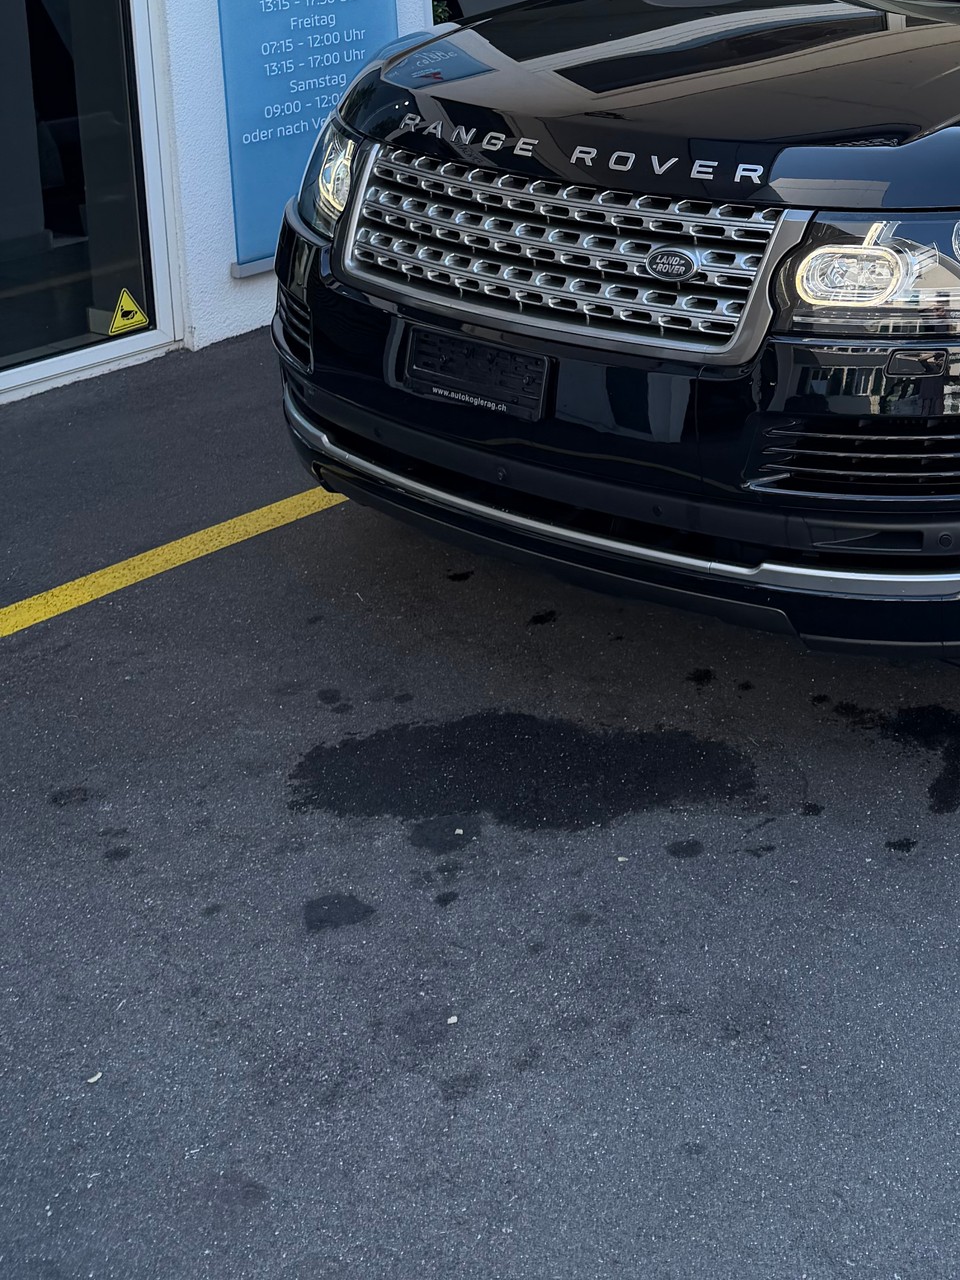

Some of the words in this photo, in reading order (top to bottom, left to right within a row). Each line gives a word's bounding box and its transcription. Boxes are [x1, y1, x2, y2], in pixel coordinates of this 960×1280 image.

[290, 14, 336, 30] Freitag
[262, 40, 294, 56] 07:15
[308, 32, 340, 46] 12:00
[344, 28, 366, 42] Uhr
[264, 60, 294, 76] 13:15
[308, 52, 340, 67] 17:00
[344, 48, 366, 62] Uhr
[290, 73, 346, 92] Samstag
[264, 101, 301, 118] 09:00
[315, 94, 343, 109] 12:0
[242, 128, 273, 144] oder
[277, 121, 308, 138] nach
[400, 113, 539, 157] RANGE
[570, 146, 765, 184] ROVER
[656, 255, 680, 265] LAND
[656, 263, 686, 274] ROVER
